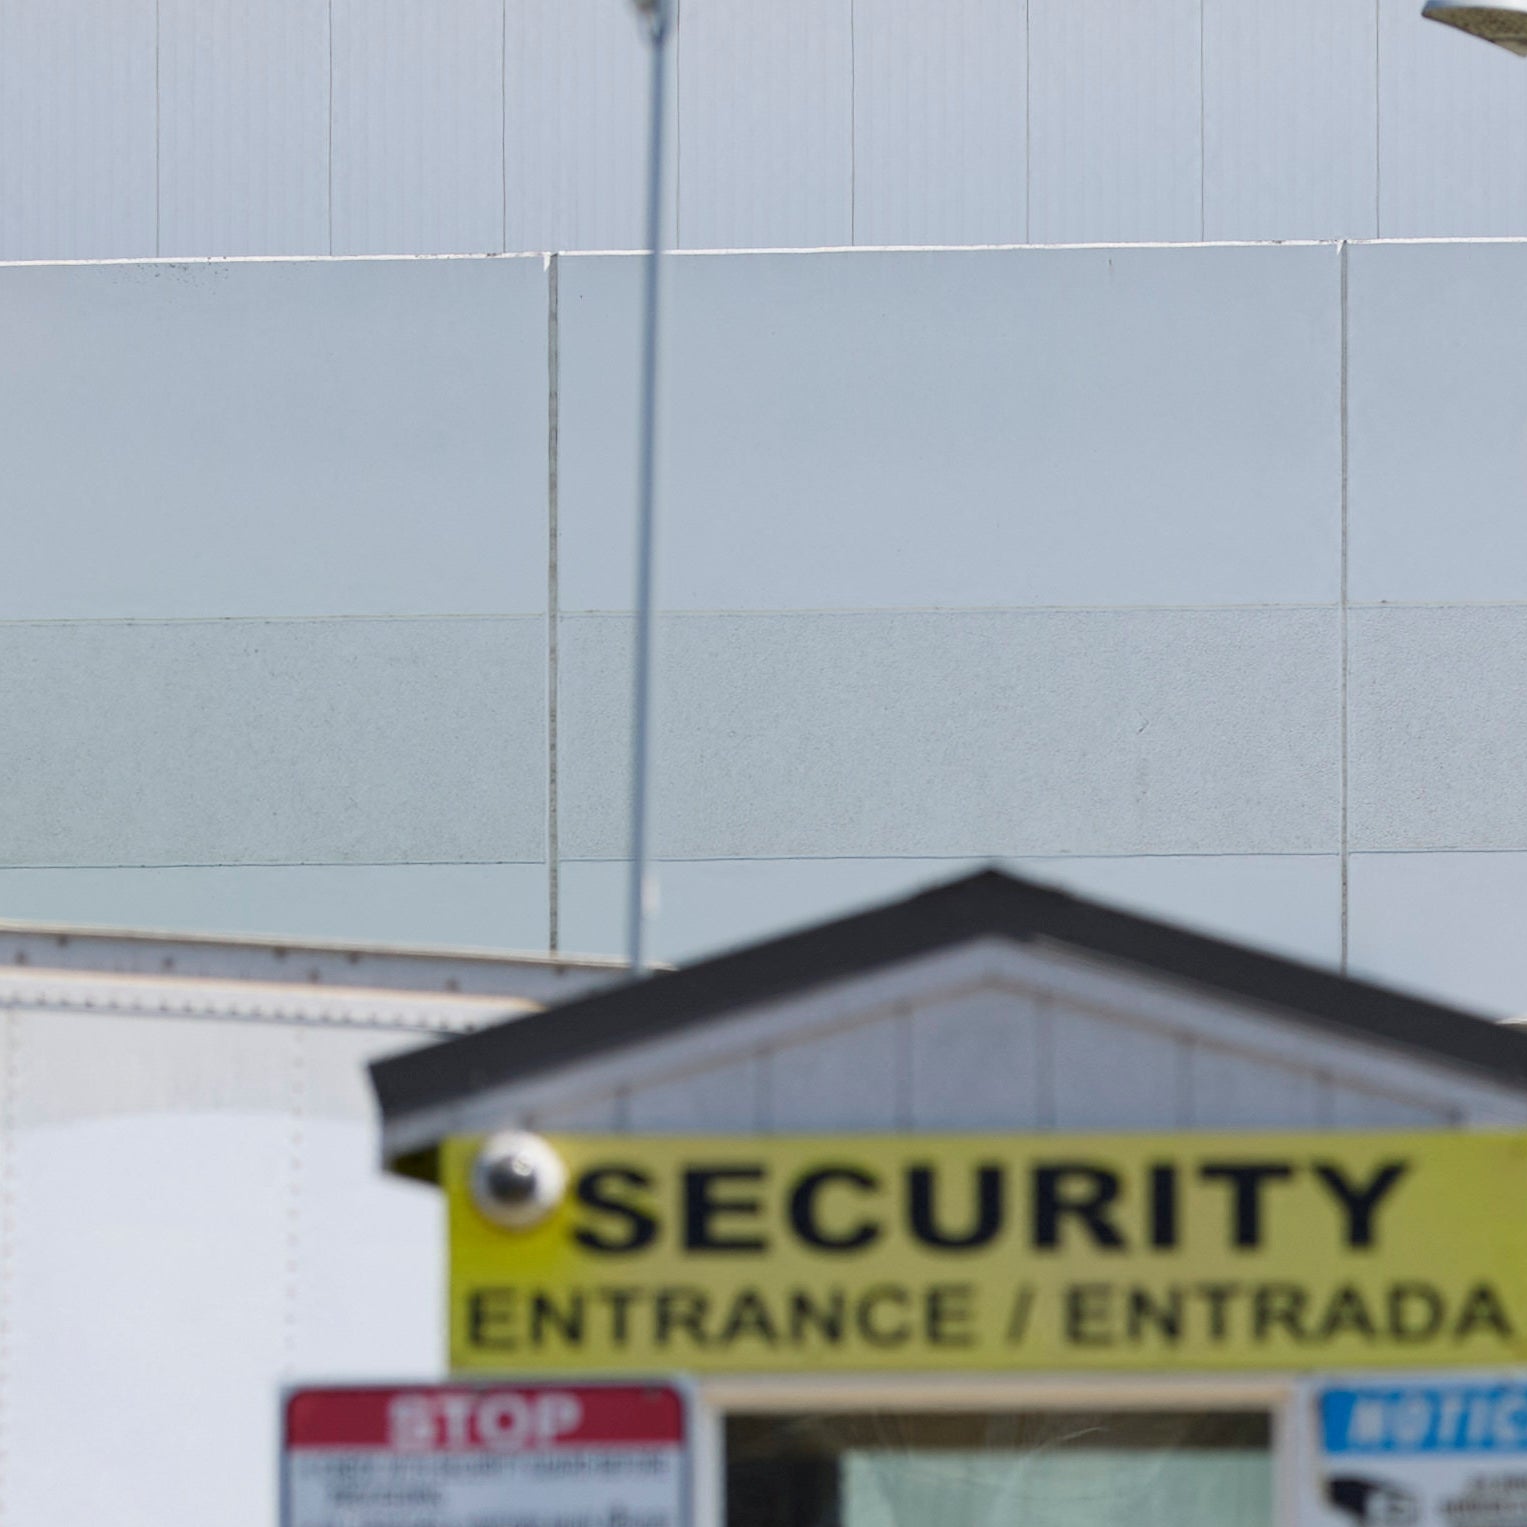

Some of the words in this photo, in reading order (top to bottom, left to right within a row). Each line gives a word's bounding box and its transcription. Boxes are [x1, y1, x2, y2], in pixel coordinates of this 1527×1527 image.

[572, 1161, 1412, 1256] SECURITY
[466, 1284, 970, 1350] ENTRANCE
[1004, 1284, 1036, 1347] /
[1064, 1281, 1515, 1348] ENTRADA
[386, 1392, 583, 1450] STOP
